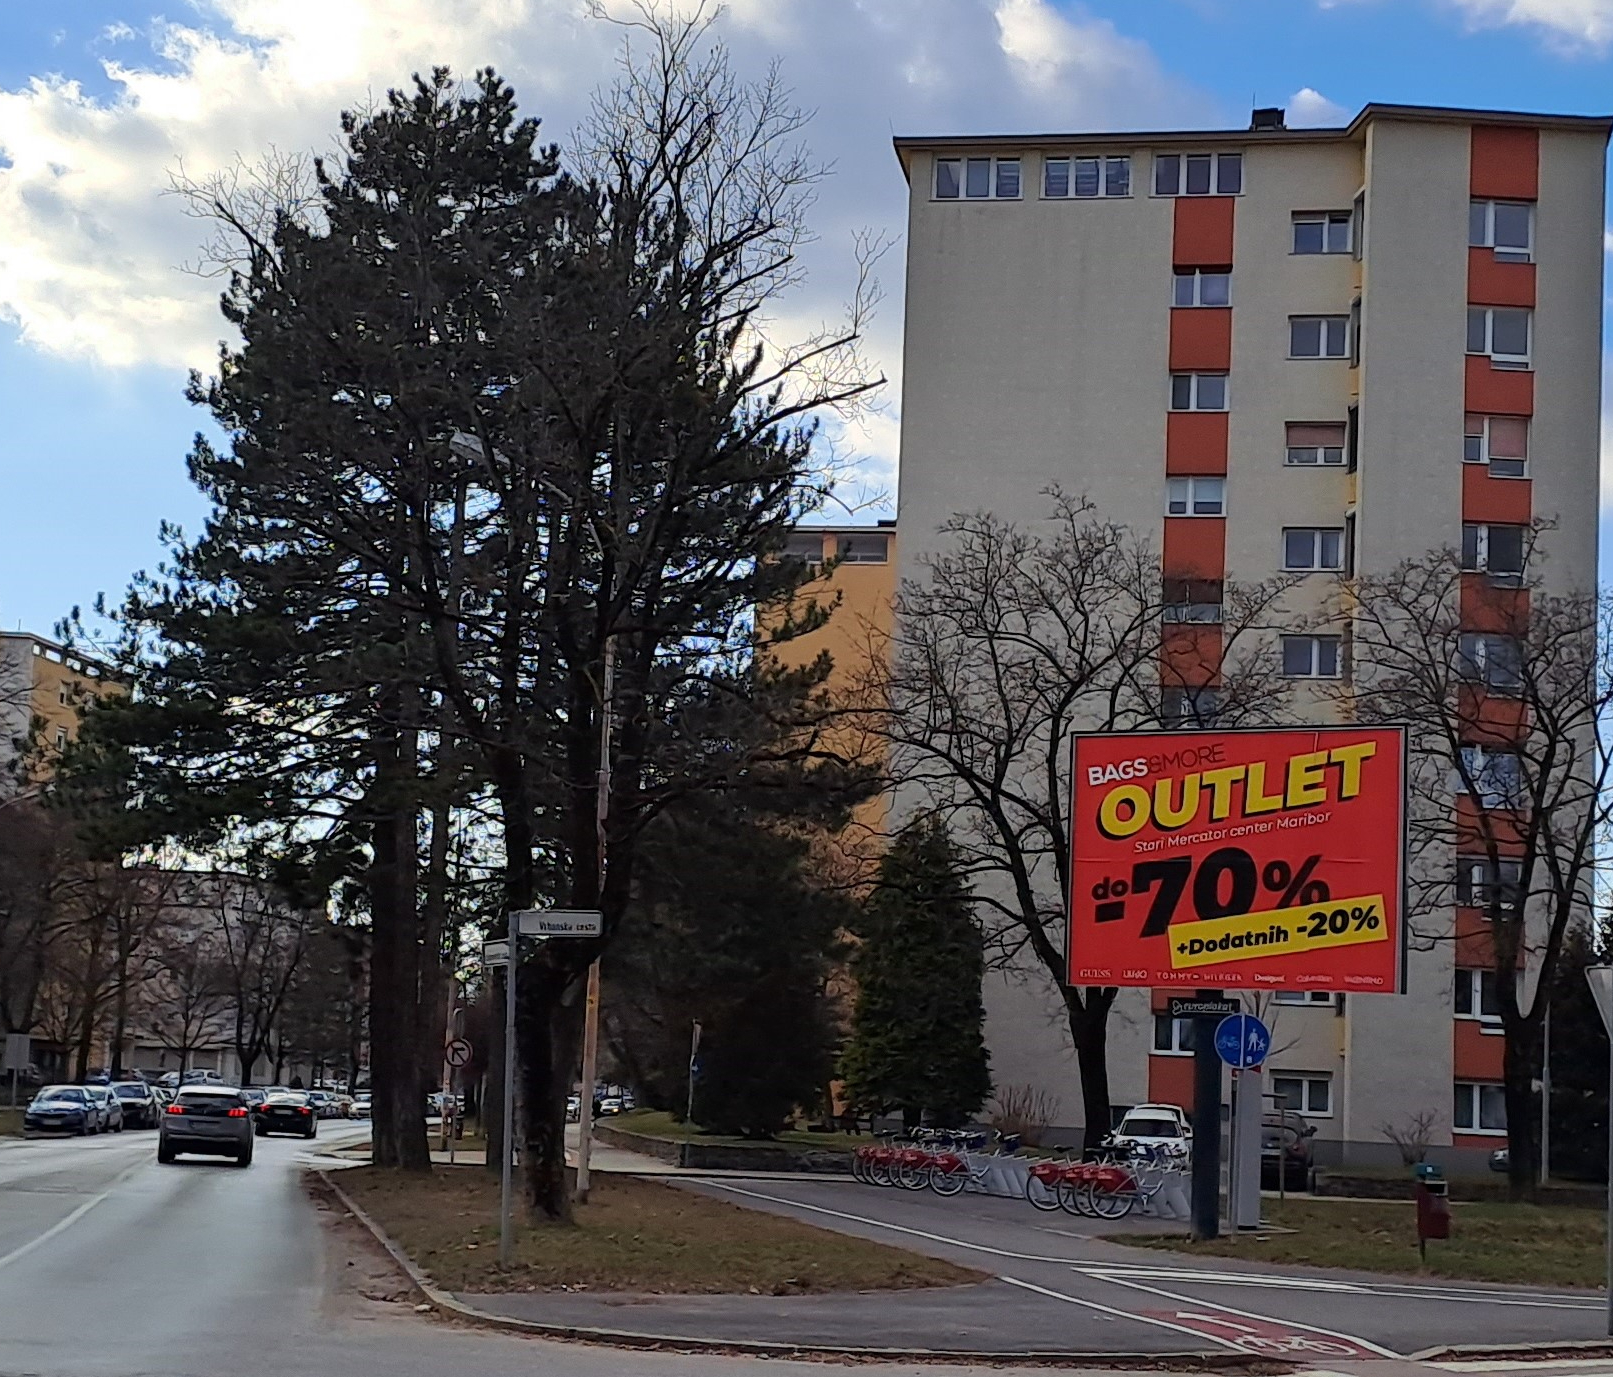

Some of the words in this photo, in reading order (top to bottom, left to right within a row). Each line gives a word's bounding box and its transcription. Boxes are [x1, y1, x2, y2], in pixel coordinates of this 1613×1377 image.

[1097, 740, 1377, 840] OUTLET
[1133, 837, 1165, 853] Stari
[1168, 828, 1228, 847] Mercator
[1230, 820, 1274, 837] center
[1277, 811, 1332, 830] Maribor
[1091, 876, 1129, 901] do
[1177, 925, 1289, 955] +Dodatnih
[1296, 905, 1380, 938] -20%
